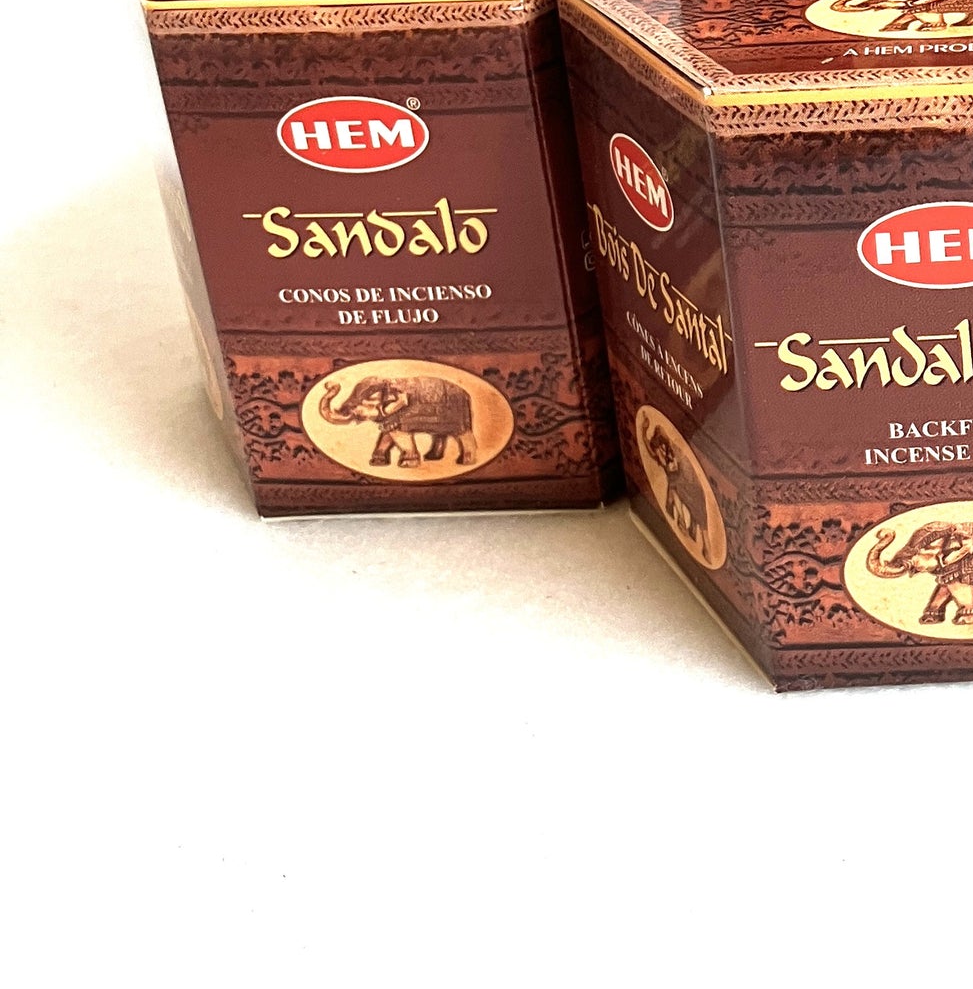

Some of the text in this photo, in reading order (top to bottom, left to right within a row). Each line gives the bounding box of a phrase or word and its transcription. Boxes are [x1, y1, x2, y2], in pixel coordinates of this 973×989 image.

[843, 47, 858, 57] A
[864, 45, 912, 56] HEM
[290, 119, 415, 151] HEM
[614, 147, 668, 218] HEM
[261, 198, 489, 258] Sandalo
[279, 284, 492, 304] CONOS DE INCIENSO
[338, 308, 439, 325] DE FLUJO
[660, 272, 728, 374] Santal
[864, 443, 971, 465] INCENSE
